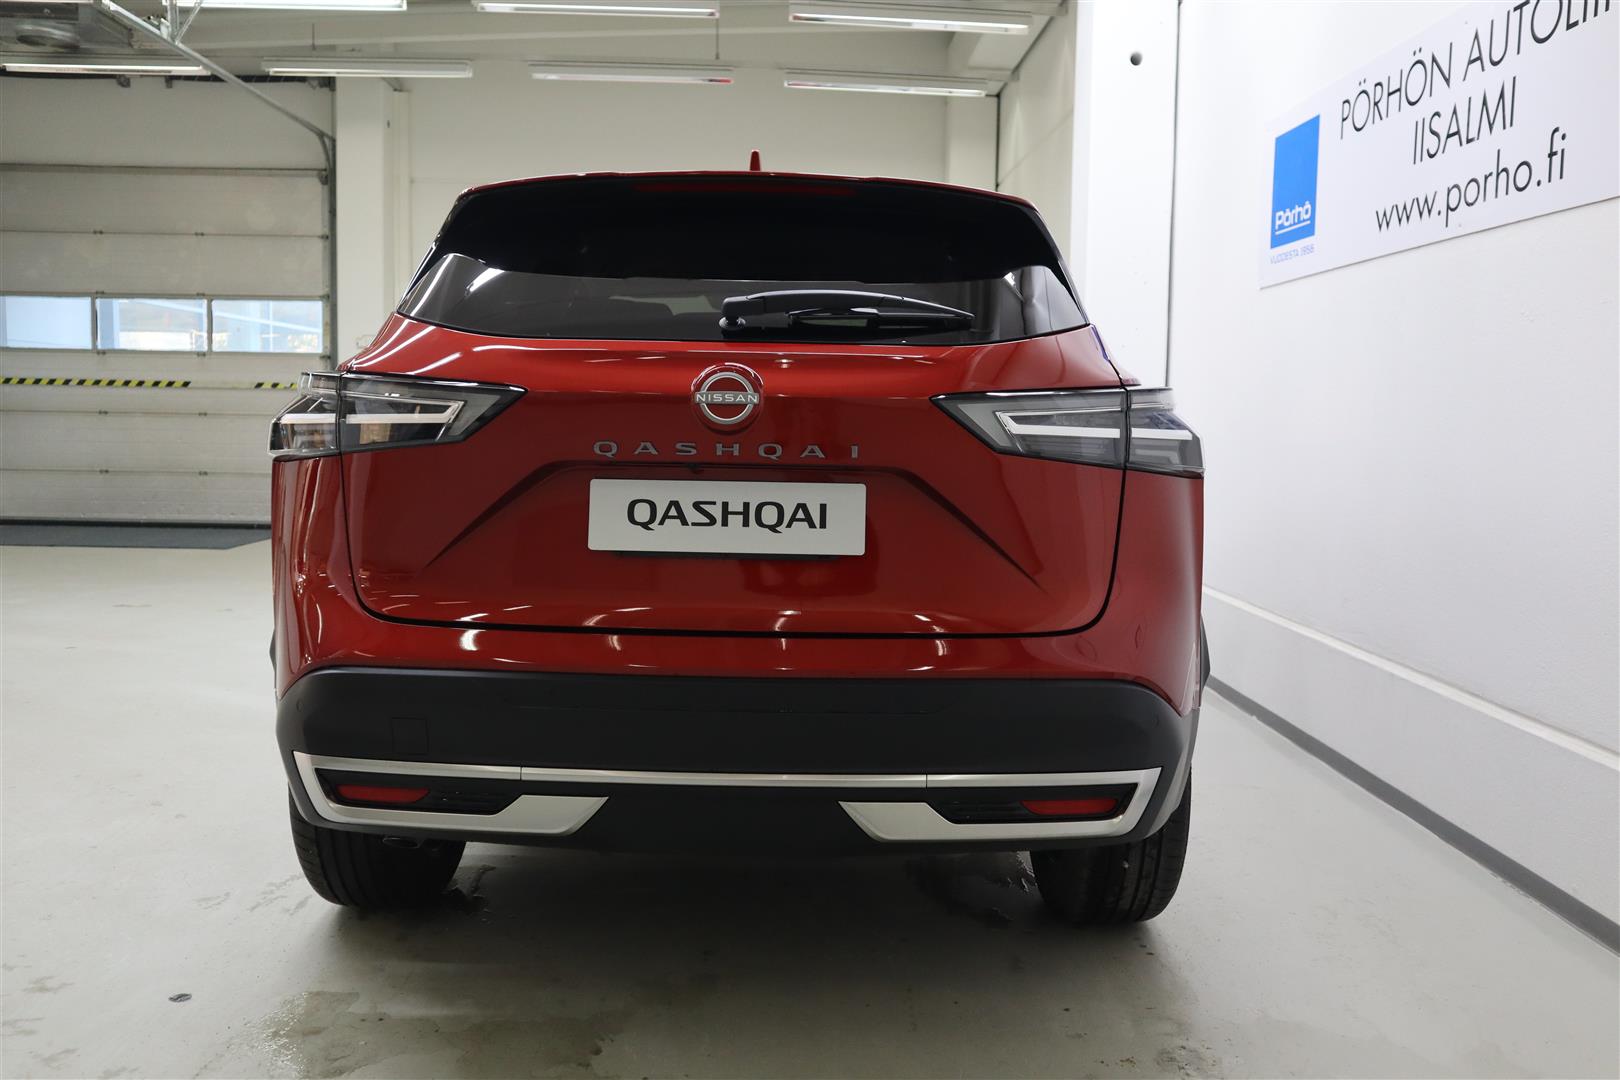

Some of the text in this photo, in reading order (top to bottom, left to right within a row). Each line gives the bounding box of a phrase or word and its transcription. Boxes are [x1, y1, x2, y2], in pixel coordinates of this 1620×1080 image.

[1340, 0, 1610, 140] PÖRHÖN AUTOL
[1413, 76, 1517, 165] IISALMI
[1375, 126, 1567, 232] www.porho.fi
[695, 392, 758, 404] NISSAN
[592, 440, 860, 460] QASHQAI
[626, 498, 828, 534] QASHQAI
